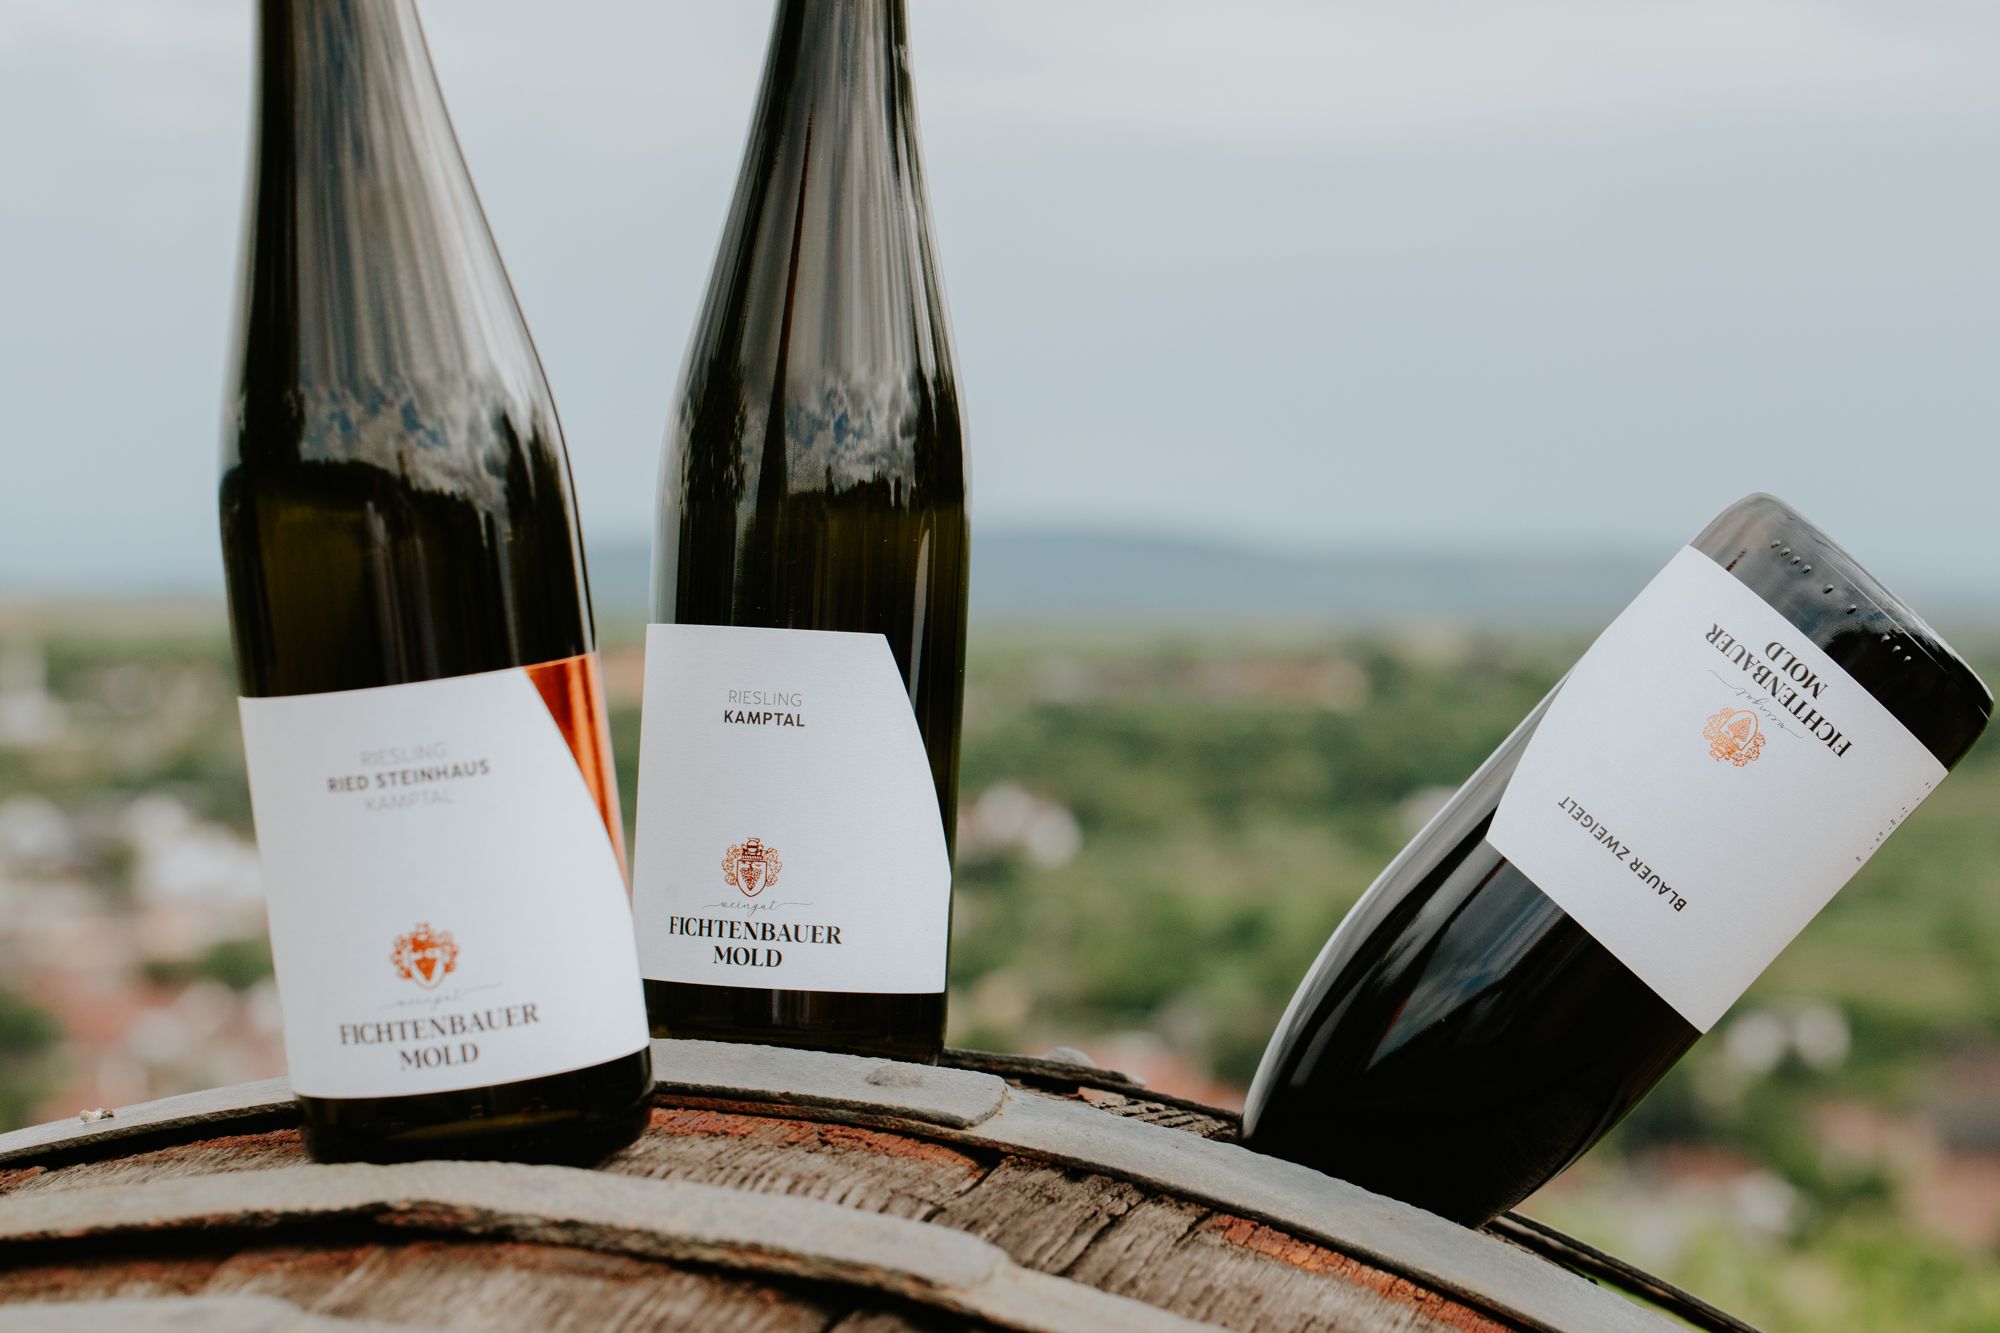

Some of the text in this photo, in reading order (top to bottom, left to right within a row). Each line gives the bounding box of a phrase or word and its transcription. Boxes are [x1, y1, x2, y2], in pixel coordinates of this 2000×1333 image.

[1765, 641, 1828, 699] MOLD
[728, 690, 802, 707] RIESLING
[1705, 622, 1853, 758] FICHTENBAUER
[723, 710, 806, 727] KAMPTAL
[327, 759, 490, 793] RIED STEINHAUS
[1558, 796, 1687, 912] BLAUER ZWEIGELT
[669, 916, 842, 945] FICHTENBAUER
[713, 945, 783, 967] MOLD
[340, 1004, 539, 1045] FICHTENBAUER
[400, 1043, 480, 1070] MOLD
